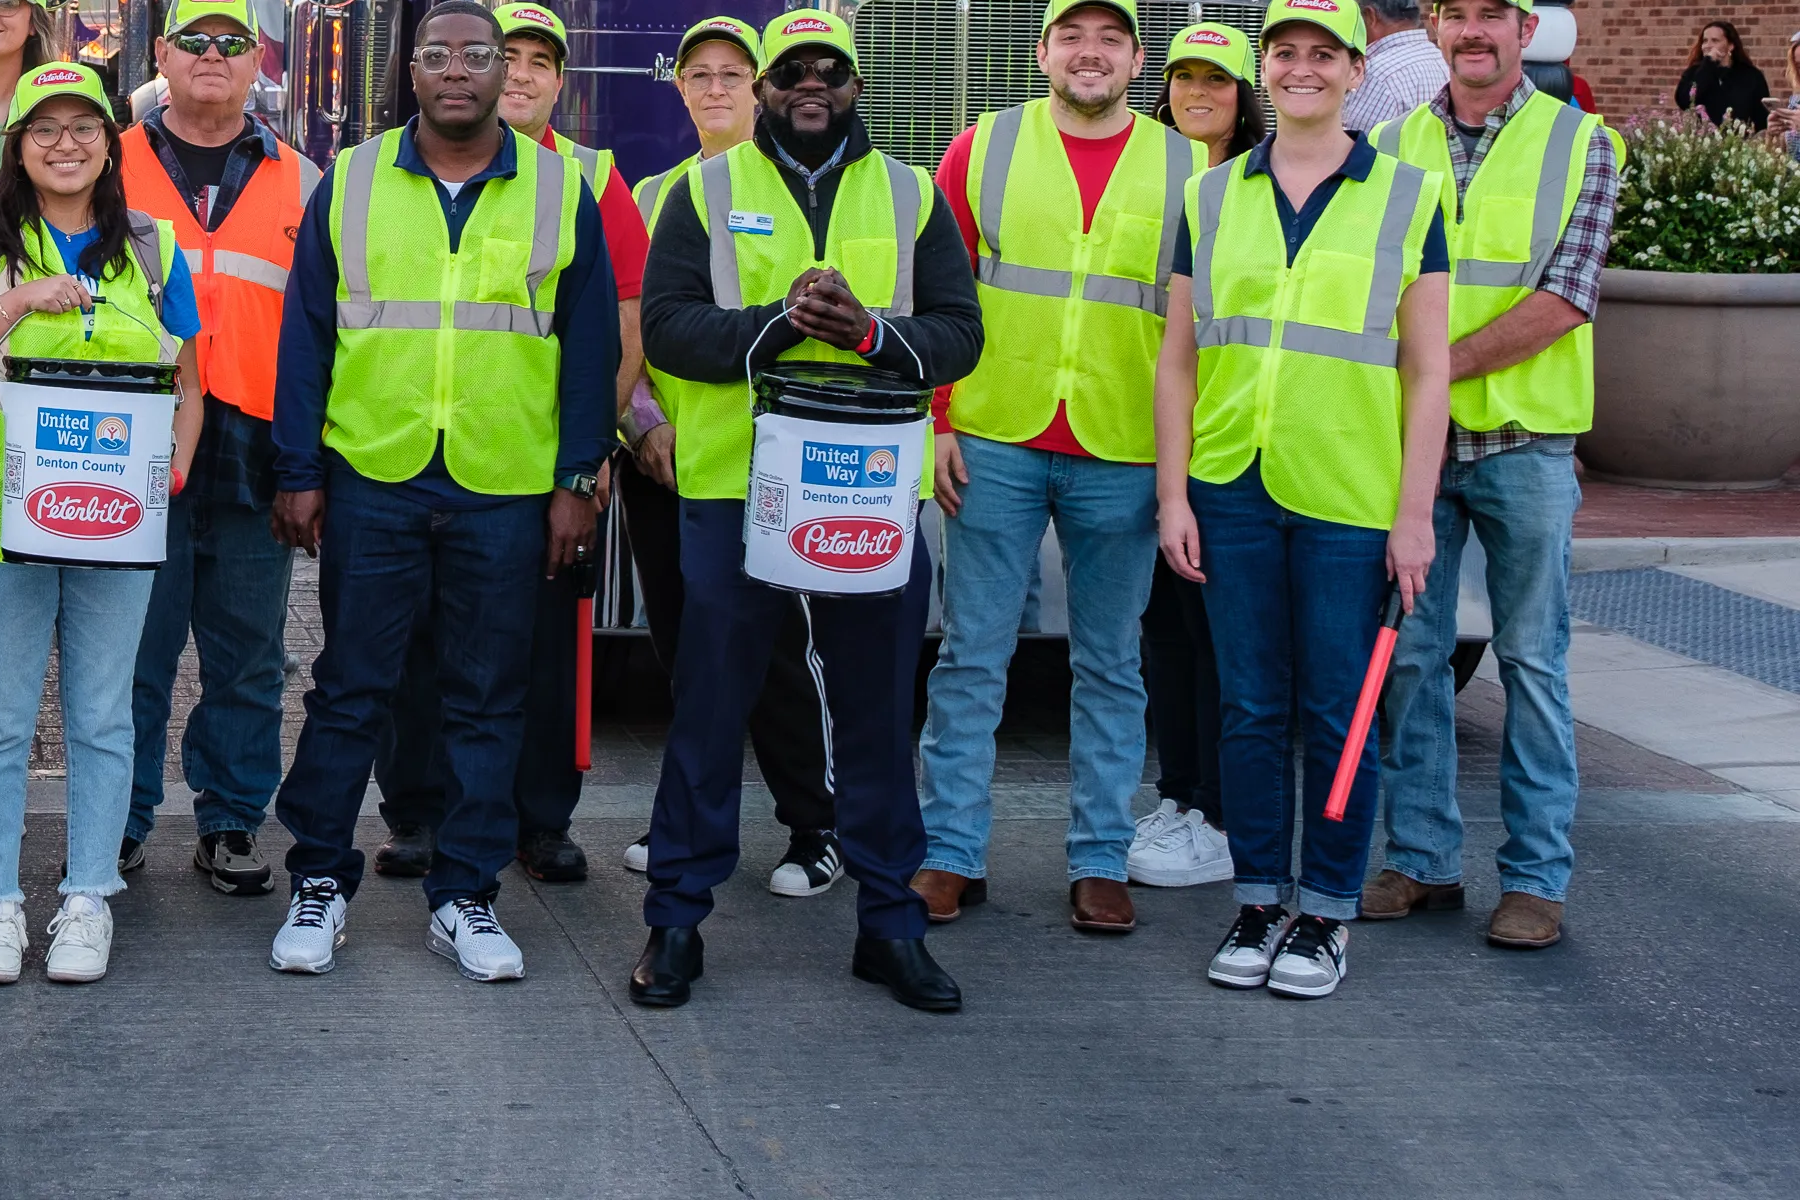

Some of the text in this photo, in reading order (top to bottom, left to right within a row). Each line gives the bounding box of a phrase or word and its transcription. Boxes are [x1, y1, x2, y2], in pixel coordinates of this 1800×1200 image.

[515, 10, 552, 25] Peterbilt
[786, 21, 827, 33] Peterbilt
[1189, 32, 1227, 46] Peterbilt
[37, 71, 77, 84] Peterbilt
[40, 412, 89, 430] United
[57, 429, 88, 451] Way
[805, 446, 859, 465] United
[37, 456, 126, 475] Denton County
[825, 464, 858, 485] Way
[802, 490, 893, 506] Denton County
[37, 490, 136, 525] Peterbilt
[804, 524, 900, 555] Peterbilt
